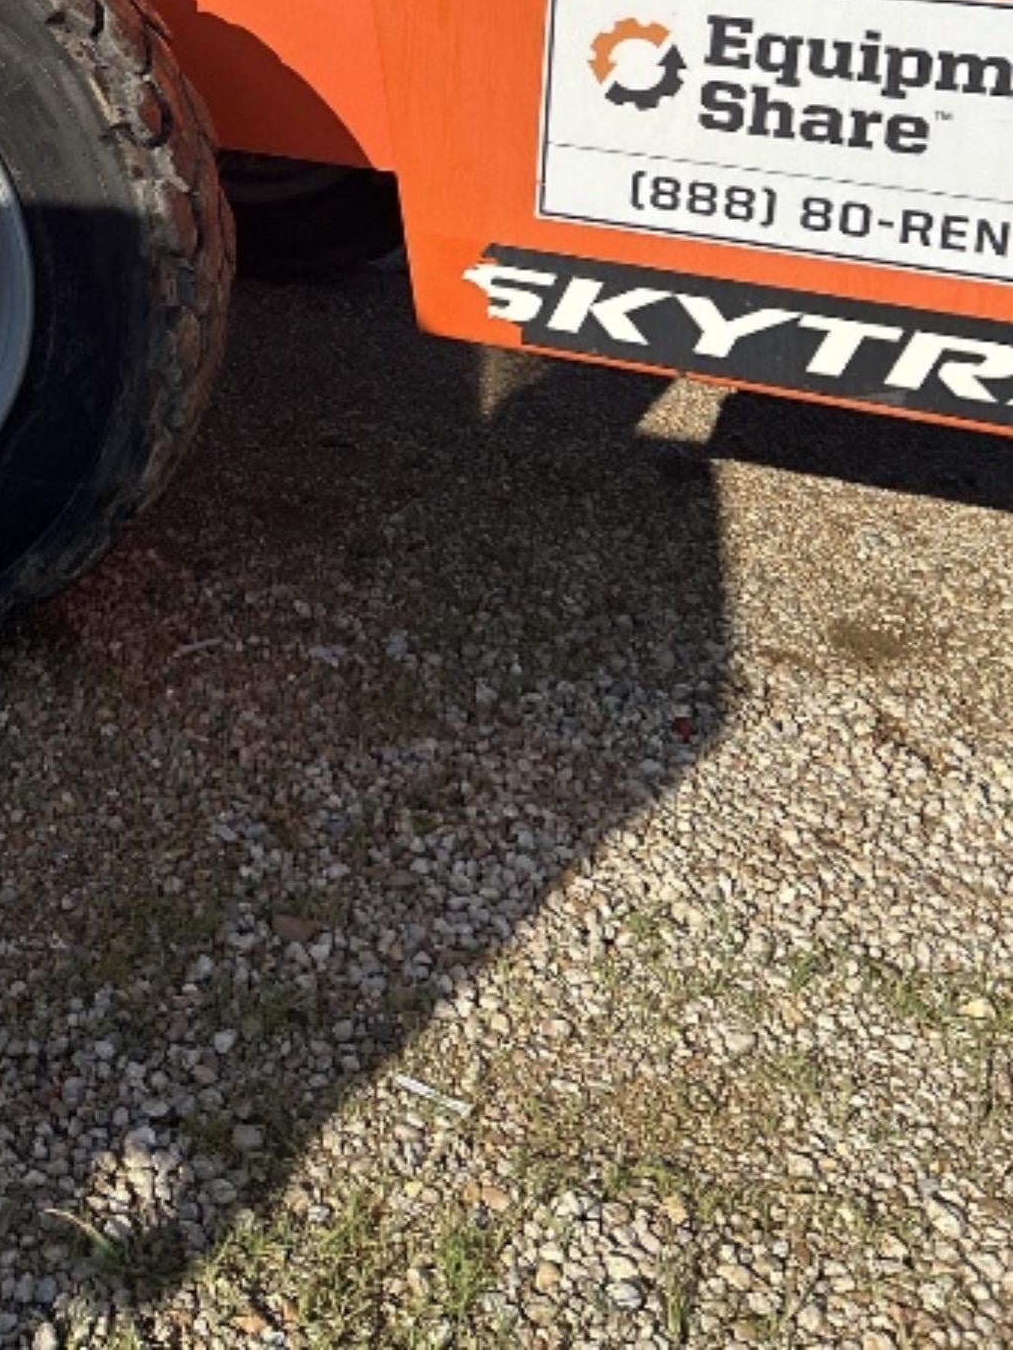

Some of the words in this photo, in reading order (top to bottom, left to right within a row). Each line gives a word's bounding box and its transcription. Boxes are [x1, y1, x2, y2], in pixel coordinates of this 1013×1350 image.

[704, 14, 1013, 100] Equipm
[698, 80, 930, 154] Share
[630, 170, 776, 227] (888)
[800, 197, 1011, 257] 80-REN
[461, 263, 1013, 405] SKYTR
